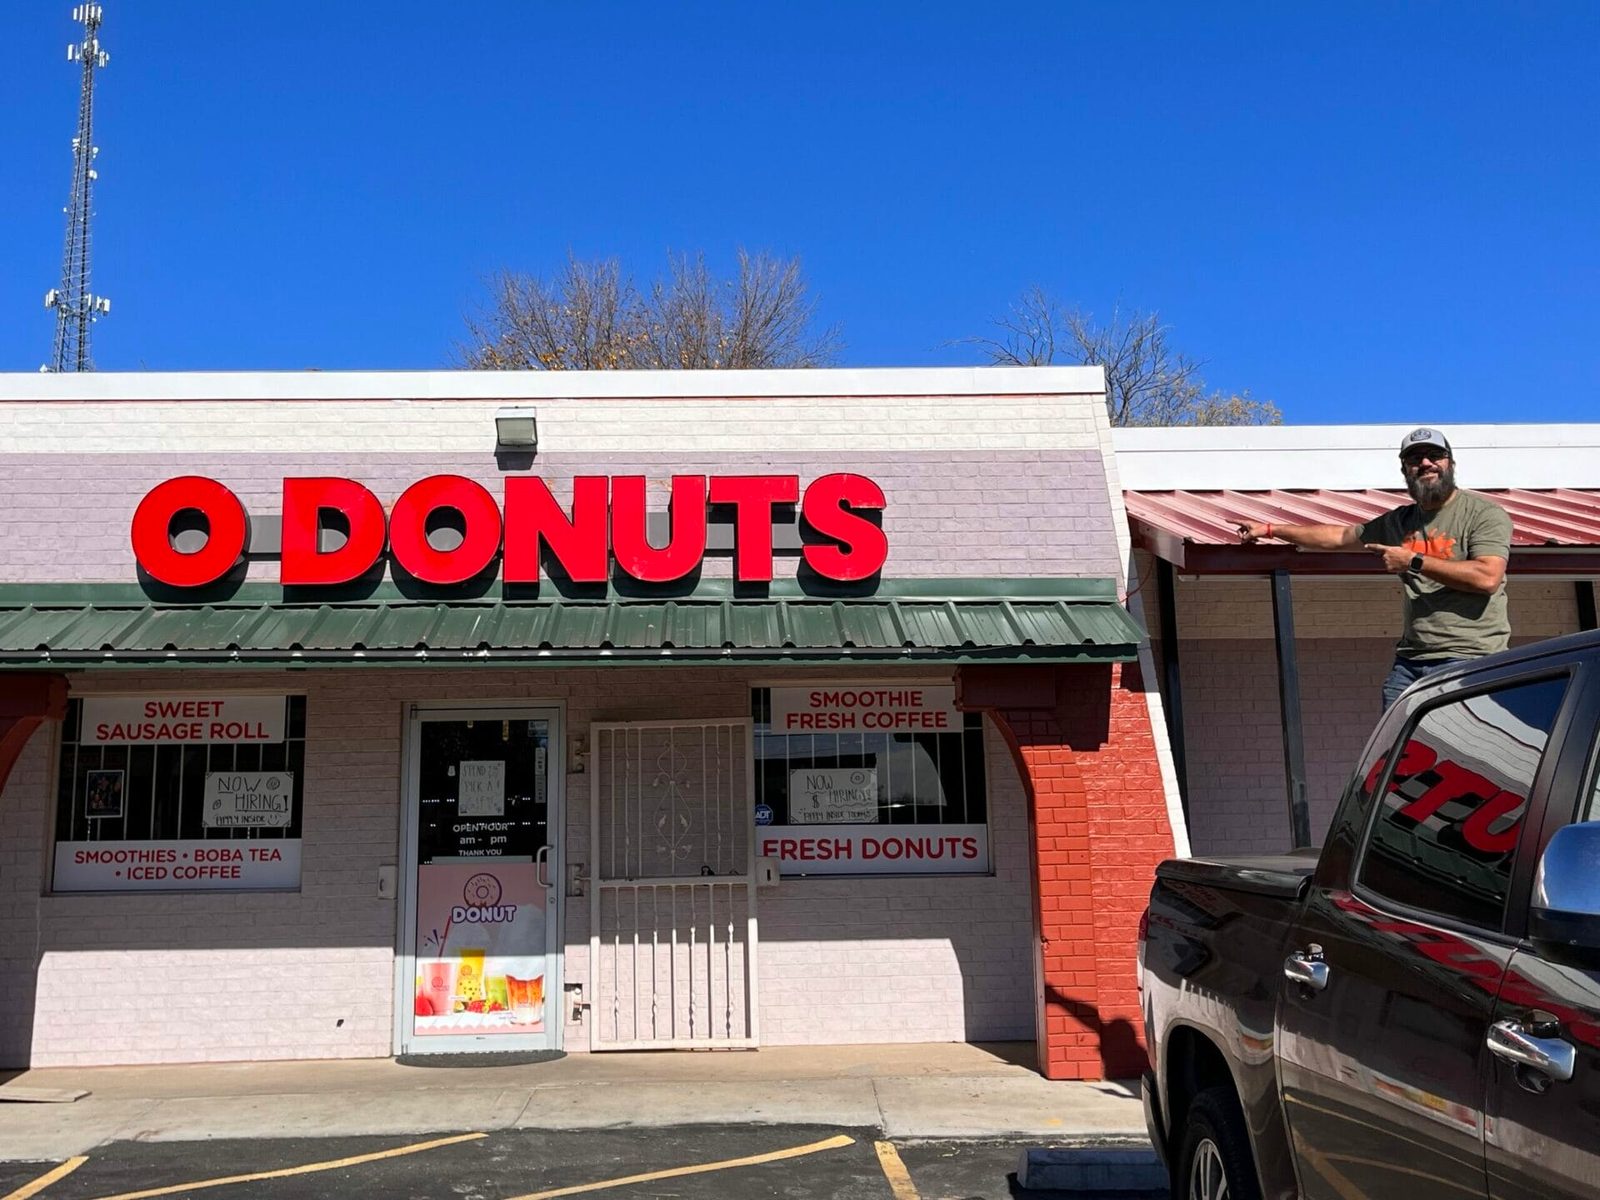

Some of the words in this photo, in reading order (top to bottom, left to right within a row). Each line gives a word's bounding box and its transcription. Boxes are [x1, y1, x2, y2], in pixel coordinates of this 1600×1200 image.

[131, 475, 246, 587] O
[280, 473, 888, 586] DONUTS
[809, 691, 923, 708] SMOOTHIE
[144, 701, 224, 718] SWEET
[786, 712, 855, 729] FRESH
[862, 711, 948, 728] COFFEE
[96, 723, 203, 740] SAUSAGE
[210, 723, 269, 739] ROLL
[218, 776, 261, 792] NOW
[806, 775, 833, 790] NOW
[755, 810, 771, 819] ADT
[453, 823, 479, 833] OPEN
[490, 835, 507, 845] pm
[75, 850, 176, 864] SMOOTHIES
[194, 849, 243, 862] BOBA
[248, 848, 282, 862] TEA
[762, 838, 851, 860] FRESH
[861, 837, 978, 860] DONUTS
[127, 867, 167, 880] ICED
[172, 866, 241, 880] COFFEE
[451, 905, 517, 924] DONUT
